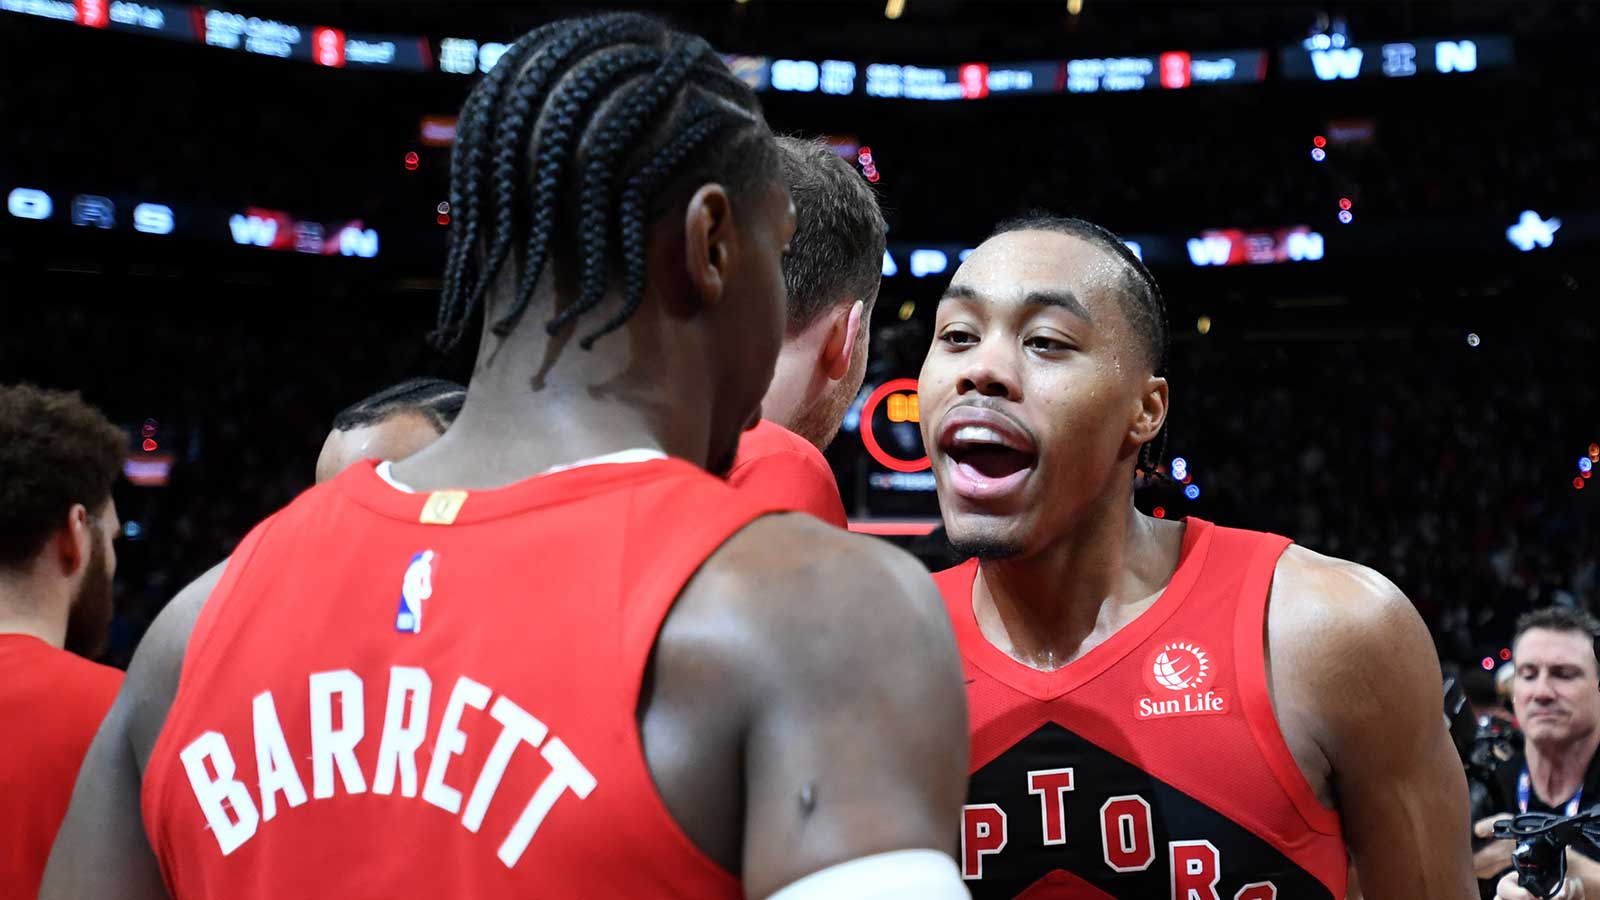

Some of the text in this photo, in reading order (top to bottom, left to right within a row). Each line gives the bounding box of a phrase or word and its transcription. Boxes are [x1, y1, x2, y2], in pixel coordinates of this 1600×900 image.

[179, 666, 598, 869] BARRETT
[1140, 691, 1224, 716] Sun Life
[961, 767, 1277, 900] PTOR
